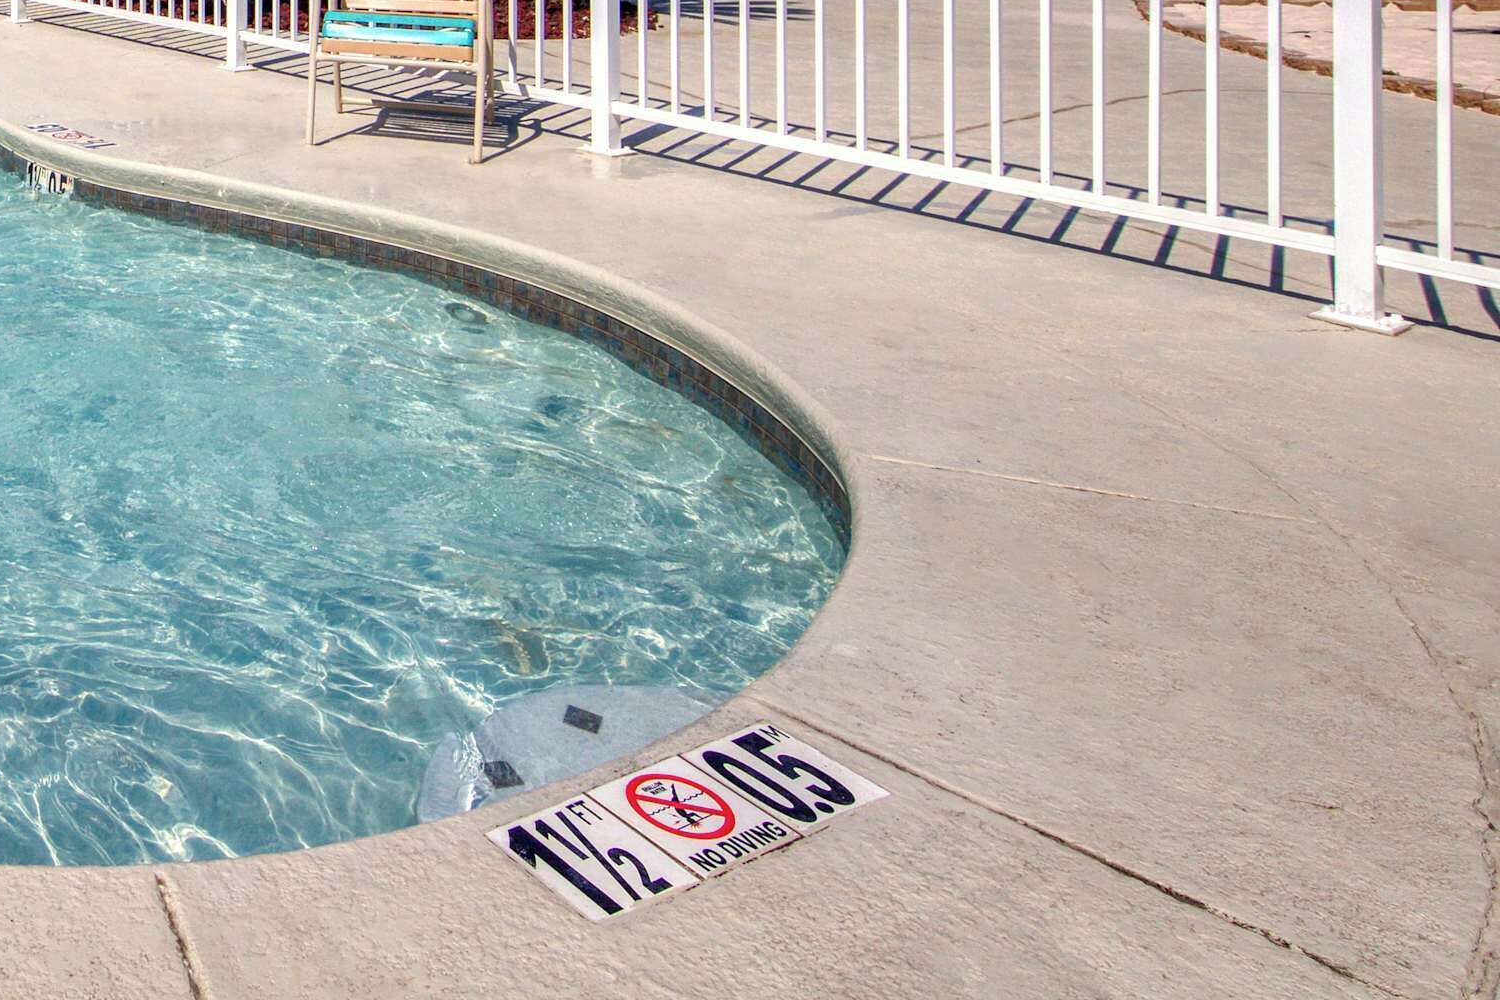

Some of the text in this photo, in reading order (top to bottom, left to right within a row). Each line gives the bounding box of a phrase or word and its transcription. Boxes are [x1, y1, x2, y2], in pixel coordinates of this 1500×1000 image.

[702, 725, 855, 823] 0.5 M
[565, 800, 603, 825] FT
[688, 821, 787, 872] NO DIVING
